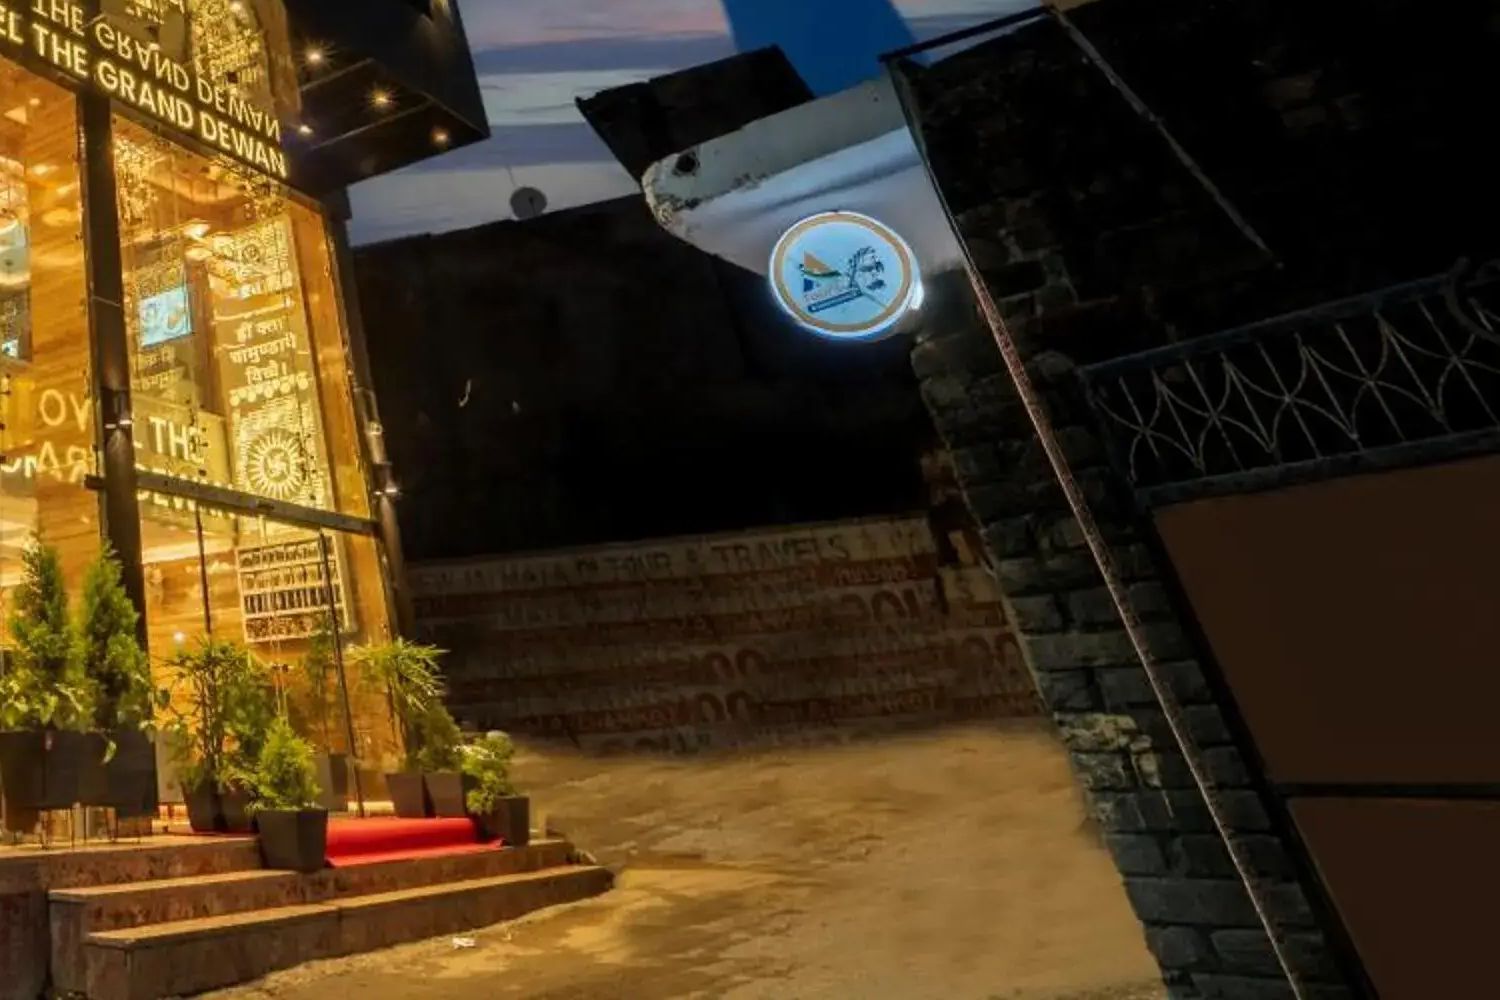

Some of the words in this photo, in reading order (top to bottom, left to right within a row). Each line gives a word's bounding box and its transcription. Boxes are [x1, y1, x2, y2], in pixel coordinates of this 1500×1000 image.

[32, 23, 89, 78] THE
[97, 63, 194, 128] GRAND
[201, 111, 288, 178] DEWAN
[710, 531, 850, 574] TRAVELS
